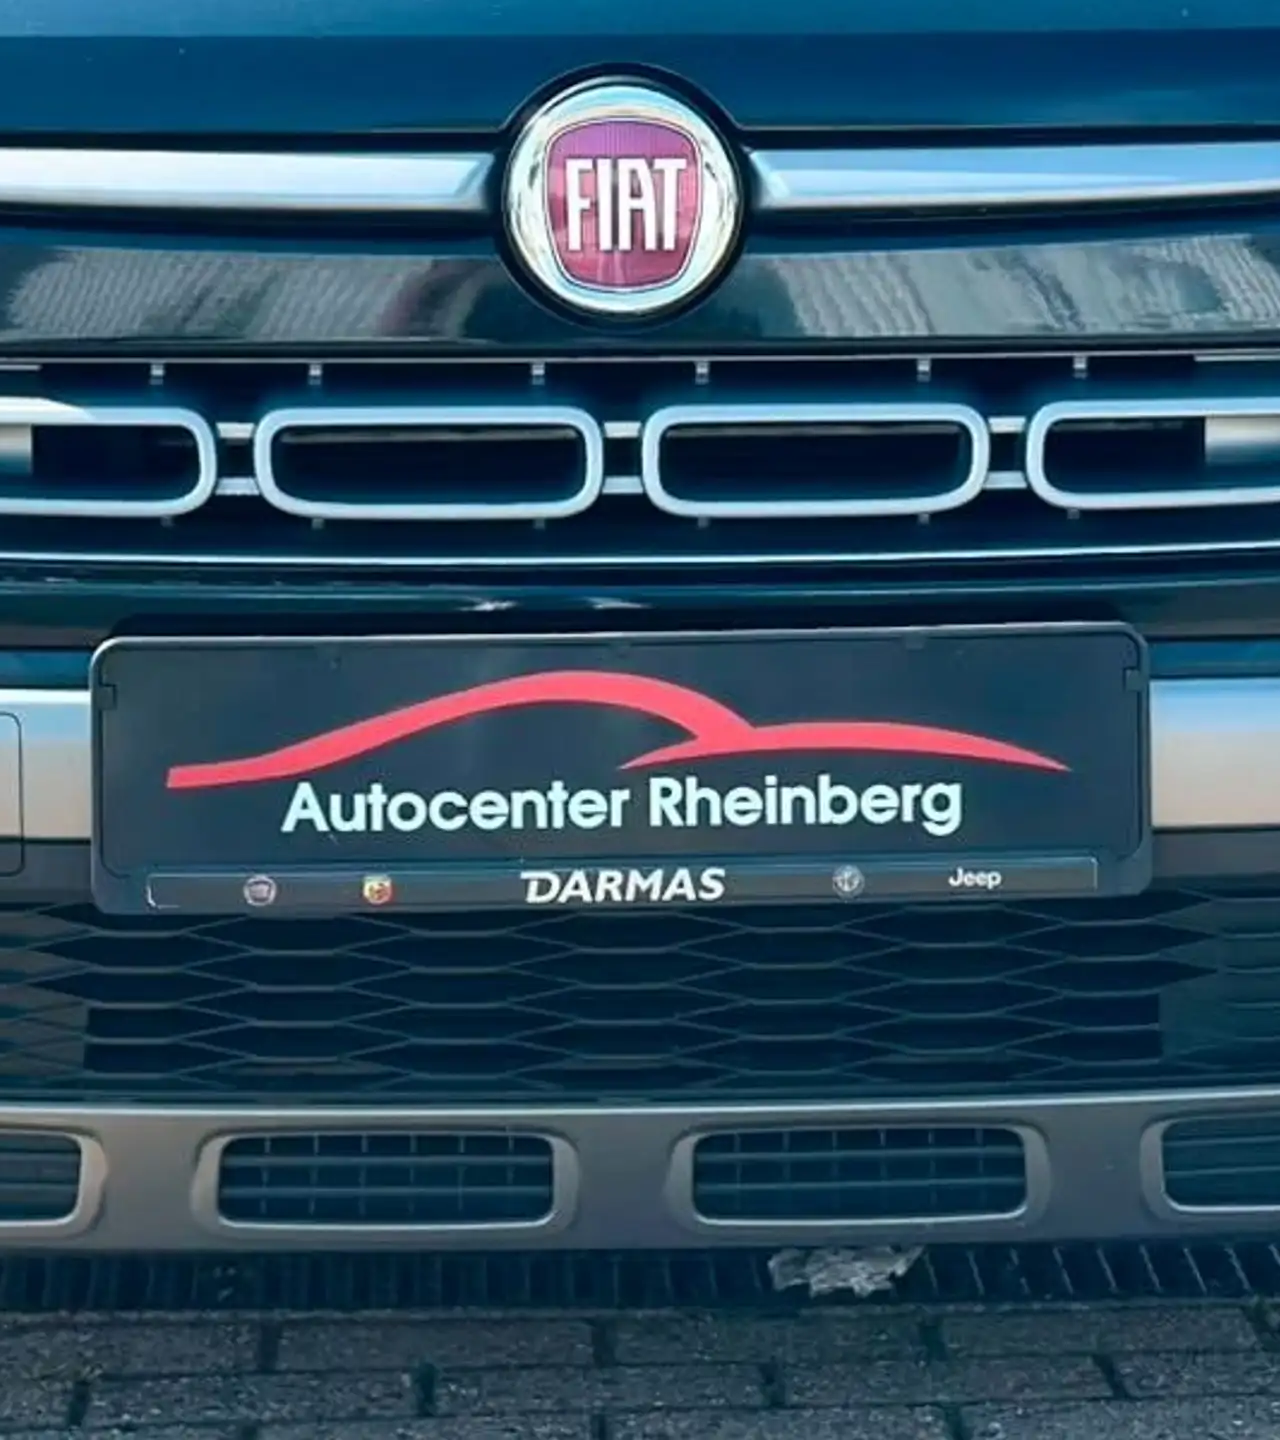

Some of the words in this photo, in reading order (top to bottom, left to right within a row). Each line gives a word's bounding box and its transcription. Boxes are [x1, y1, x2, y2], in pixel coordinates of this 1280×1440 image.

[565, 157, 687, 252] FIAT
[281, 780, 631, 832] Autocenter
[649, 774, 962, 836] Rheinberg
[520, 867, 726, 903] DARMAS
[947, 866, 1003, 890] Jeep
